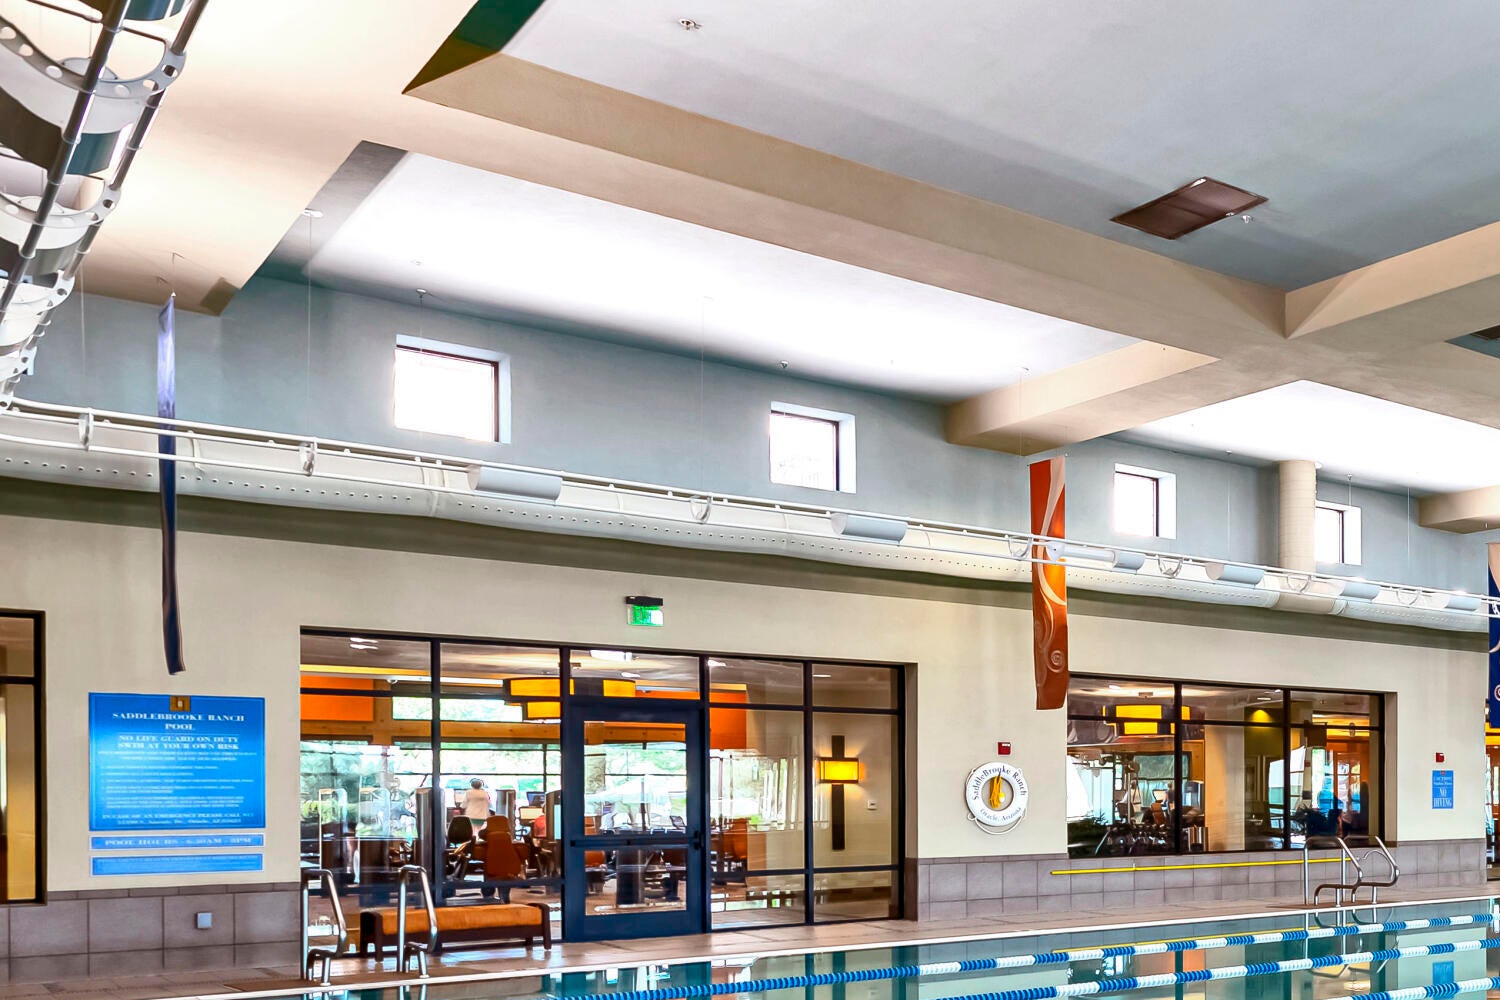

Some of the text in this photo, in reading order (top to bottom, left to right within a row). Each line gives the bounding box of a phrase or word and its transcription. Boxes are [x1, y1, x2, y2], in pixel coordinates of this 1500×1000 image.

[112, 712, 245, 722] SADDLEBROOKE RANCH
[972, 764, 1028, 801] SaddleBrooke Ranch
[1439, 787, 1447, 797] NO
[1433, 797, 1453, 808] DIVING
